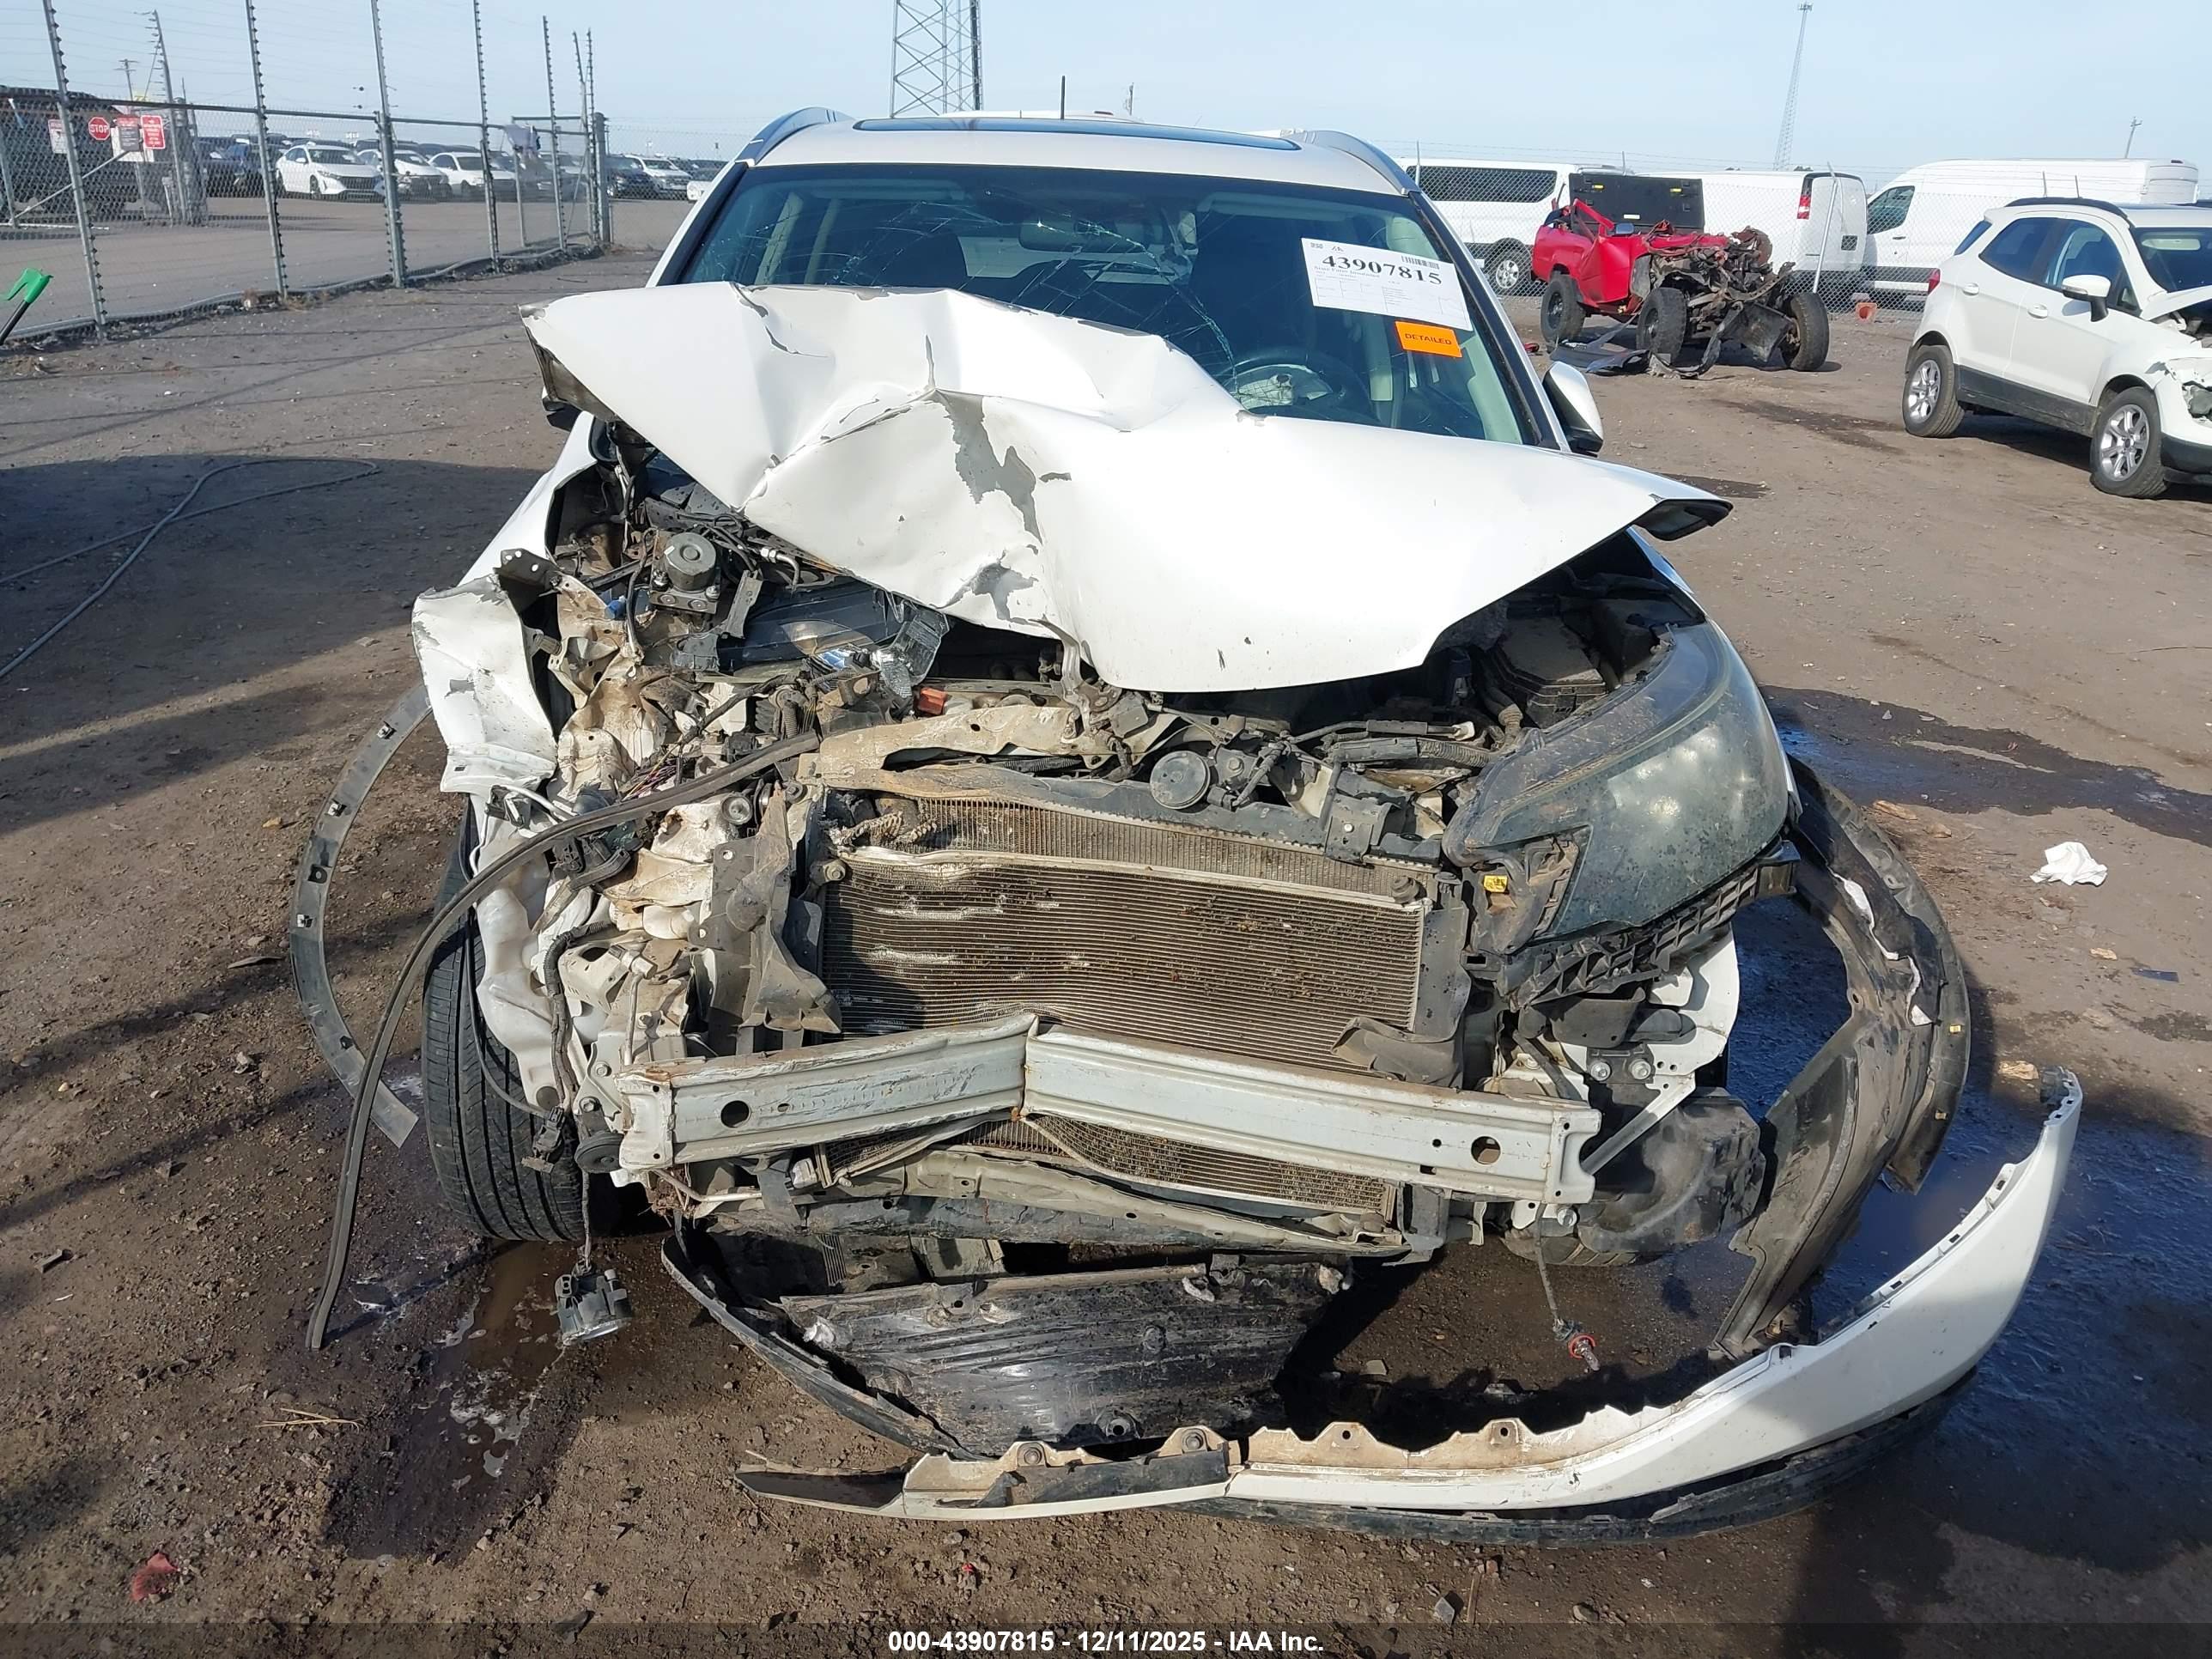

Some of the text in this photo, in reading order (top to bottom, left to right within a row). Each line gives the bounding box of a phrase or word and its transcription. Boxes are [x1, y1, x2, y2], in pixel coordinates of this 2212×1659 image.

[91, 124, 109, 134] STOP
[1322, 256, 1442, 285] 43907815
[1405, 332, 1452, 345] DETAILED
